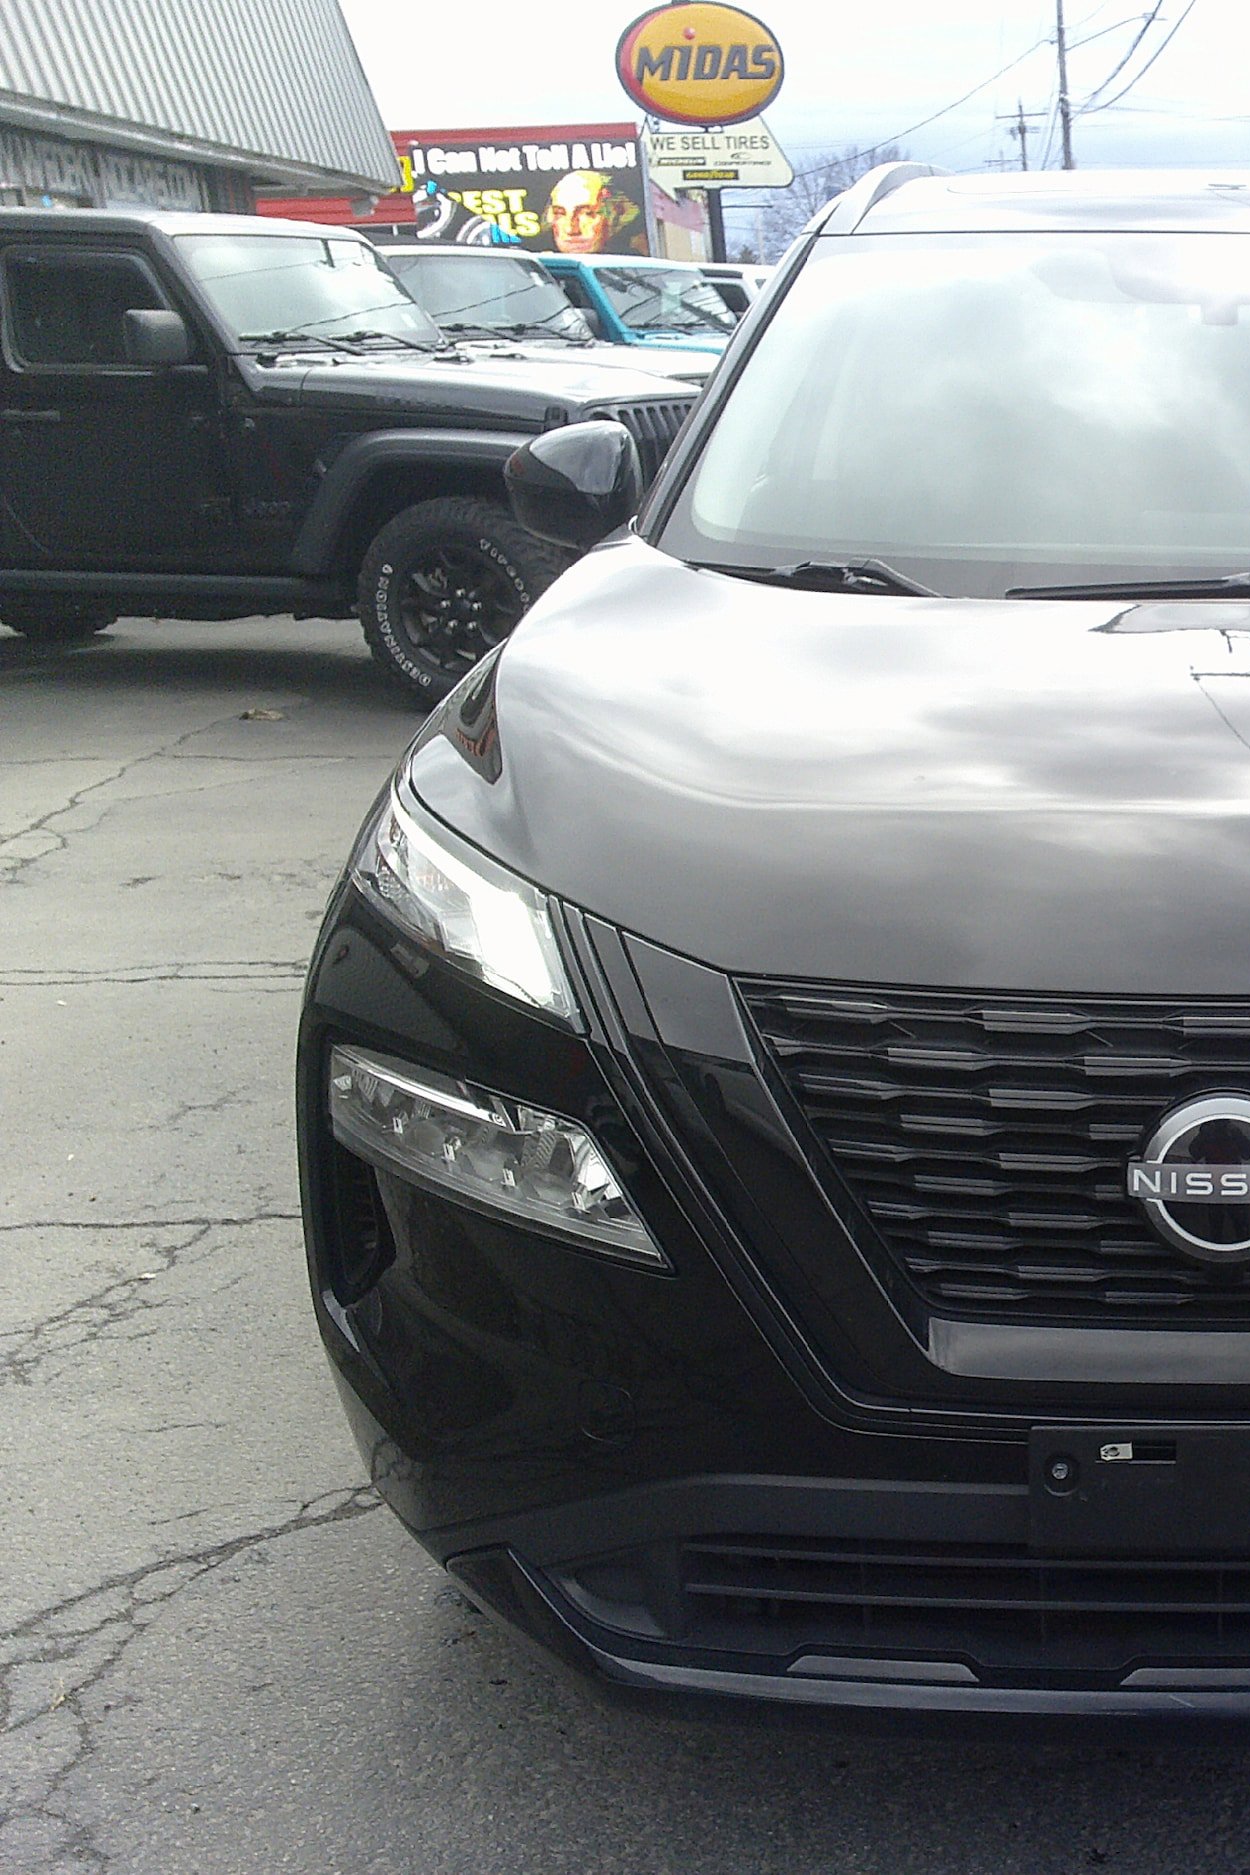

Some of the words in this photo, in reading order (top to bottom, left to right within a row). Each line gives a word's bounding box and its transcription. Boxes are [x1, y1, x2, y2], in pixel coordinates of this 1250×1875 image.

[635, 43, 777, 86] MIDAS
[413, 149, 426, 174] I
[427, 148, 478, 175] Can
[479, 147, 522, 173] Not
[522, 145, 569, 171] Tell
[571, 143, 591, 169] A
[651, 136, 675, 151] WE
[681, 136, 720, 150] SELL
[725, 135, 770, 149] TIRES
